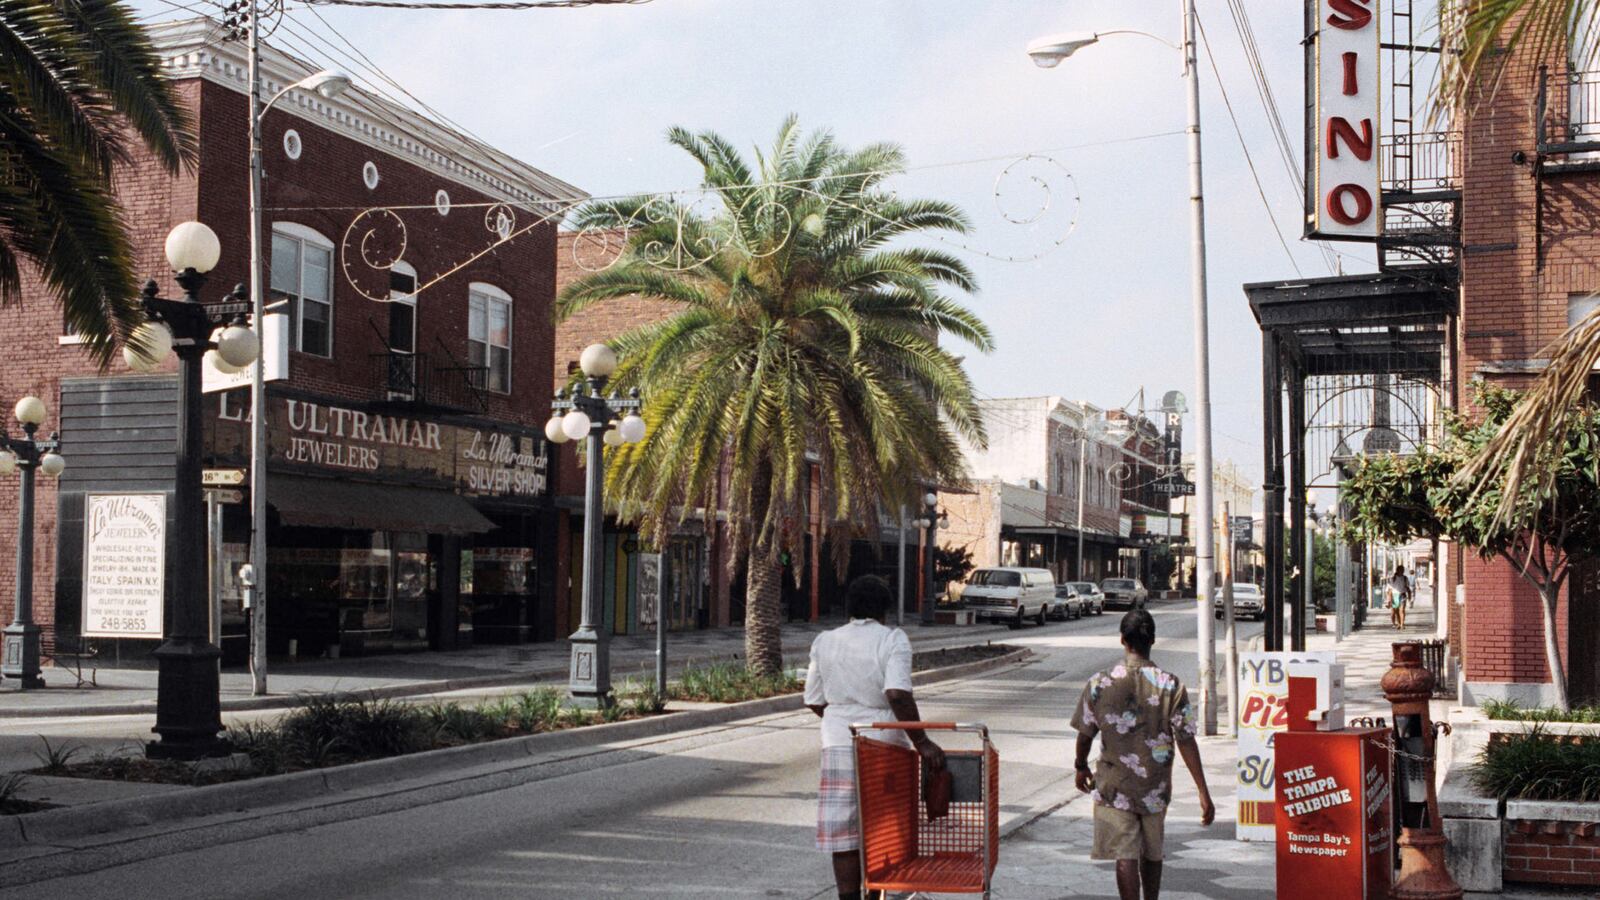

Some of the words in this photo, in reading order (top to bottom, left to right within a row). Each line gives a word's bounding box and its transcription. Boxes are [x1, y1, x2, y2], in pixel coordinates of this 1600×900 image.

[286, 399, 442, 450] ULTRAMAR
[286, 437, 379, 471] JEWELERS
[464, 430, 486, 461] La
[489, 432, 547, 469] Ultramar
[470, 465, 510, 494] SILVER
[514, 472, 543, 495] SHOP
[1152, 483, 1194, 493] THEATRE
[91, 505, 106, 542] La
[107, 497, 161, 540] Ultramar
[104, 527, 148, 538] JEWELERS
[117, 575, 143, 586] SPAIN
[1283, 765, 1316, 785] THE
[1284, 777, 1338, 801] TAMPA
[1284, 788, 1352, 818] TRIBUNE
[1287, 832, 1320, 846] Tampa
[1323, 833, 1351, 846] Bay's
[1289, 844, 1347, 858] Newspaper
